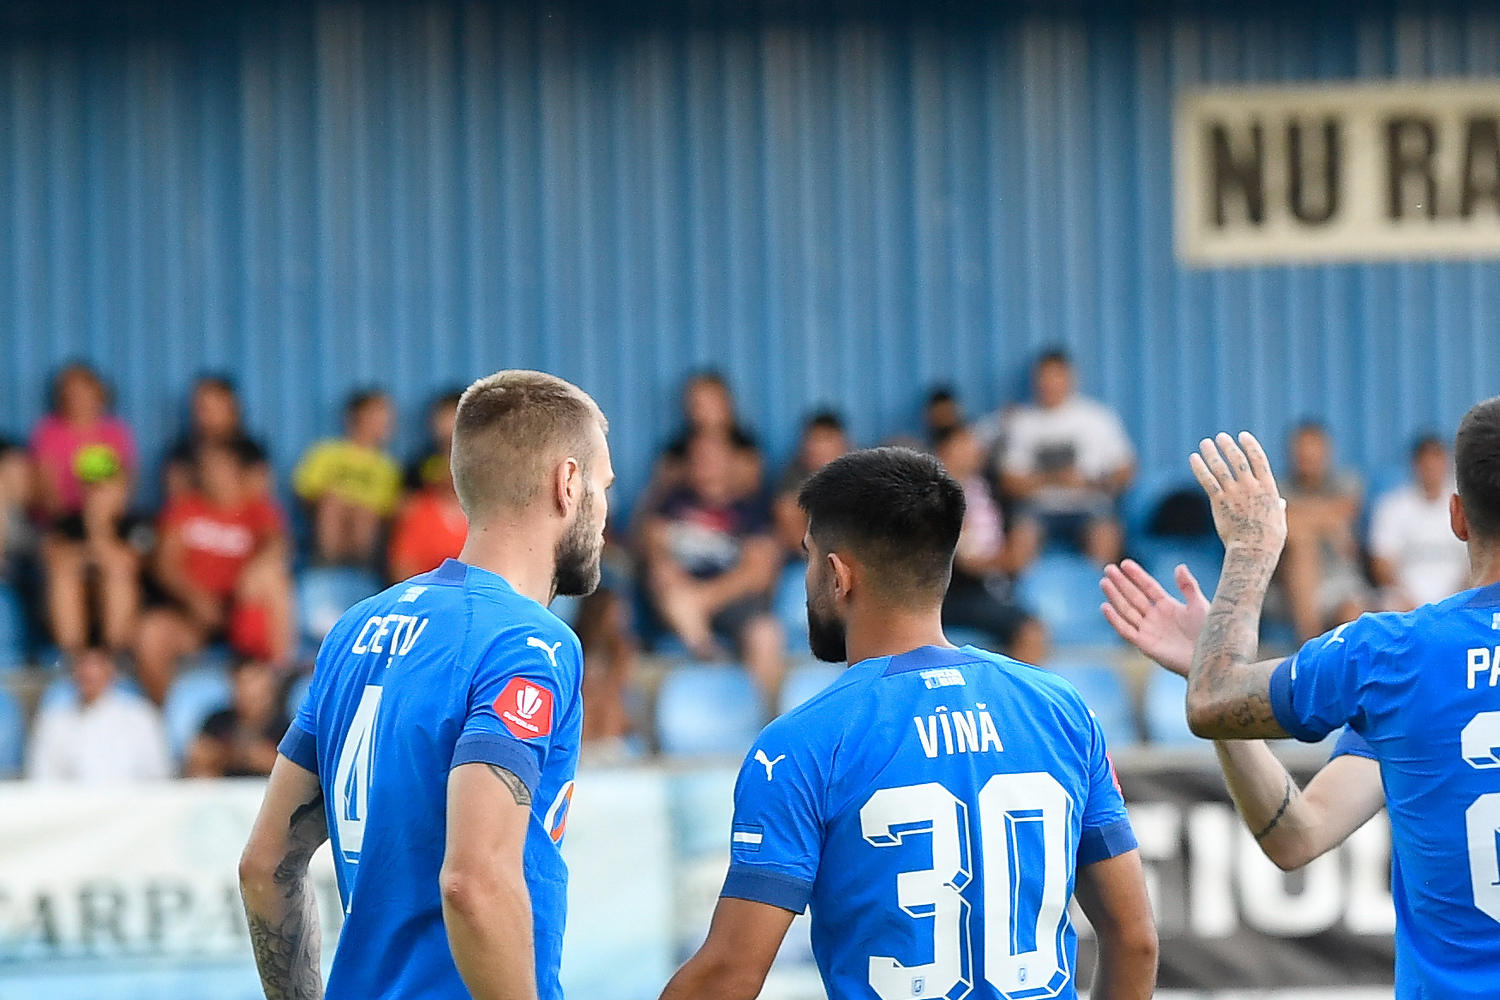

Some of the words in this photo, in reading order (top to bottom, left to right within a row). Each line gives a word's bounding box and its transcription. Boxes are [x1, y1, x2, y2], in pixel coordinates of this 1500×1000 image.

[1209, 121, 1341, 227] NU
[913, 702, 1004, 758] VÎNĂ
[334, 685, 384, 890] 4
